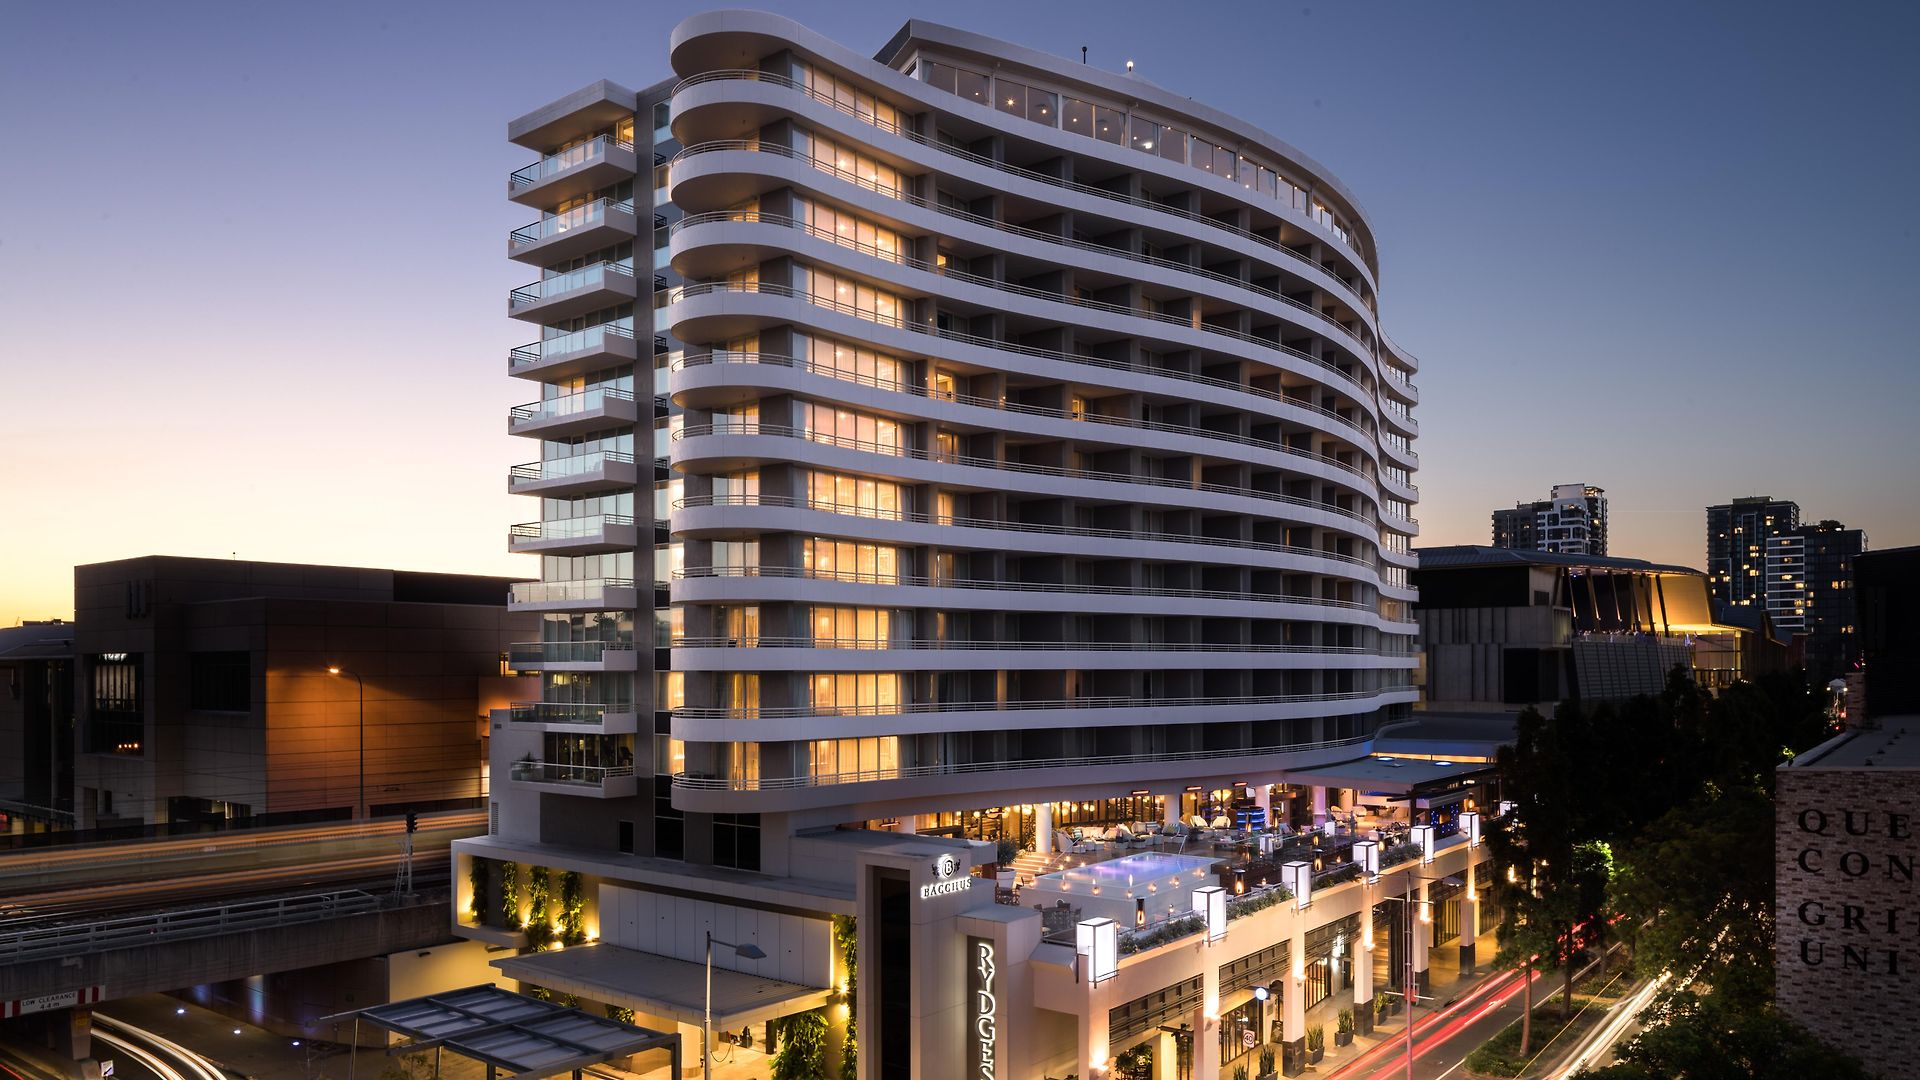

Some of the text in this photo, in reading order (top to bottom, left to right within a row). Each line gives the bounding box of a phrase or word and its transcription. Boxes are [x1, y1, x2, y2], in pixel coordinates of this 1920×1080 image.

[1798, 808, 1912, 840] QUE
[1798, 848, 1915, 881] CON
[923, 878, 972, 897] BACCHUS
[1798, 901, 1920, 935] GRI
[1799, 939, 1899, 975] UNI
[38, 992, 76, 1004] CLEARANCE
[976, 943, 996, 1080] RYDGES
